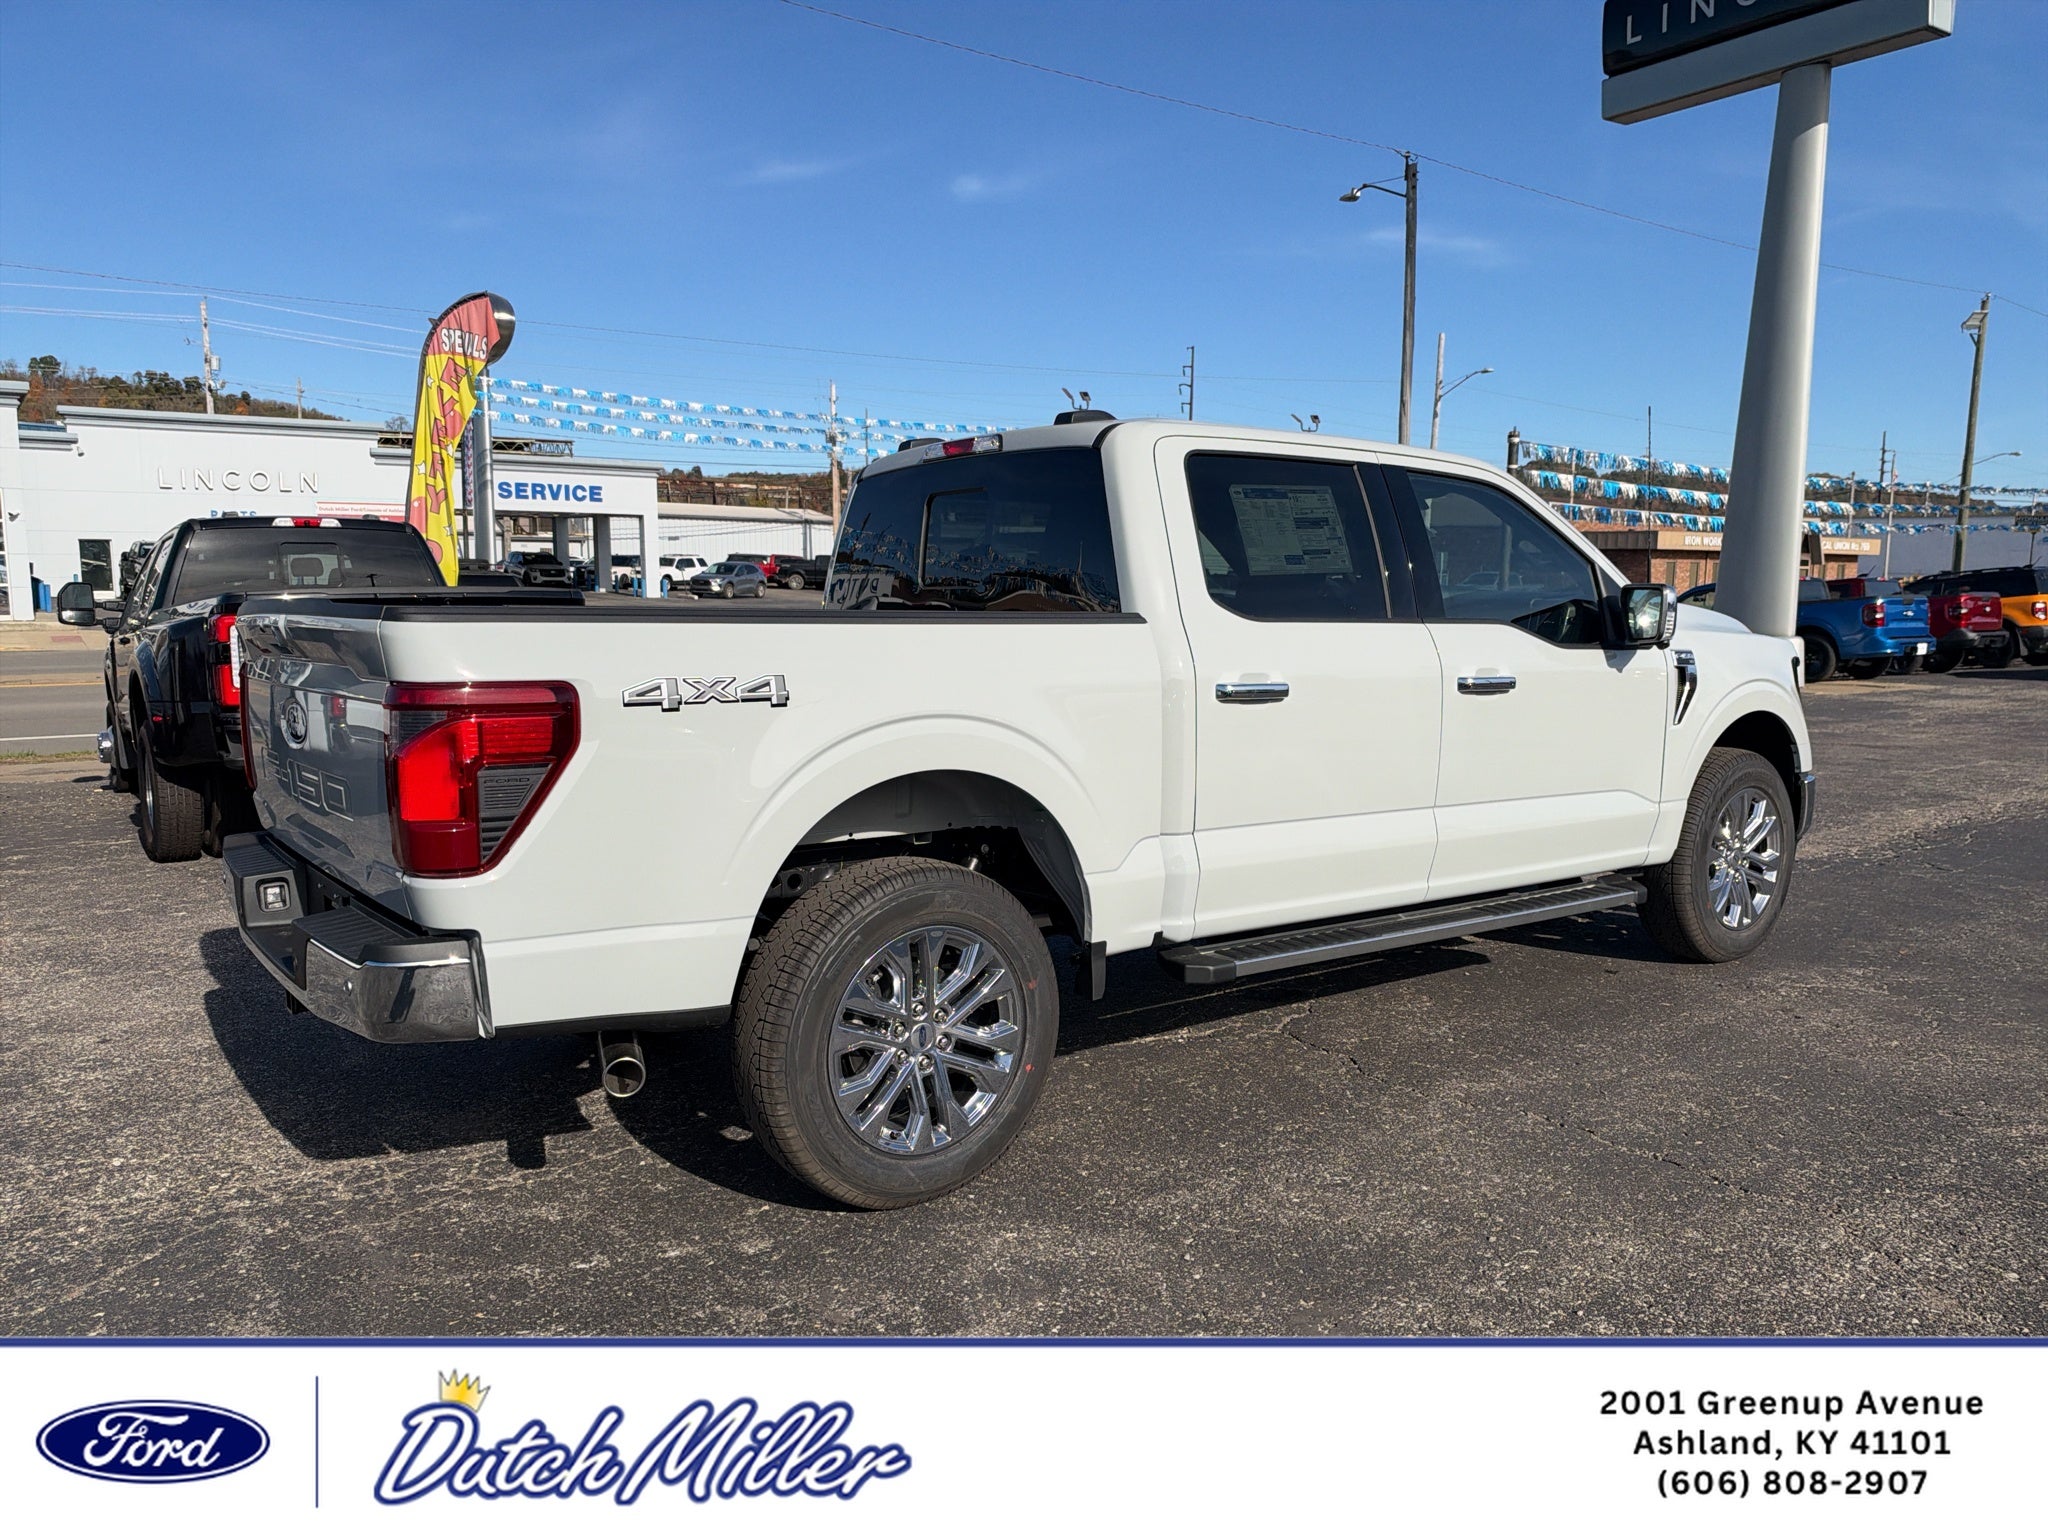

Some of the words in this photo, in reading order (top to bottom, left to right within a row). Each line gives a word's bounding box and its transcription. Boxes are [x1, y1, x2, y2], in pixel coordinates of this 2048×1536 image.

[1626, 0, 1758, 45] LIN
[158, 467, 319, 493] LINCOLN
[497, 481, 603, 503] SERVICE
[1684, 535, 1702, 546] IRON
[261, 746, 354, 822] F-150
